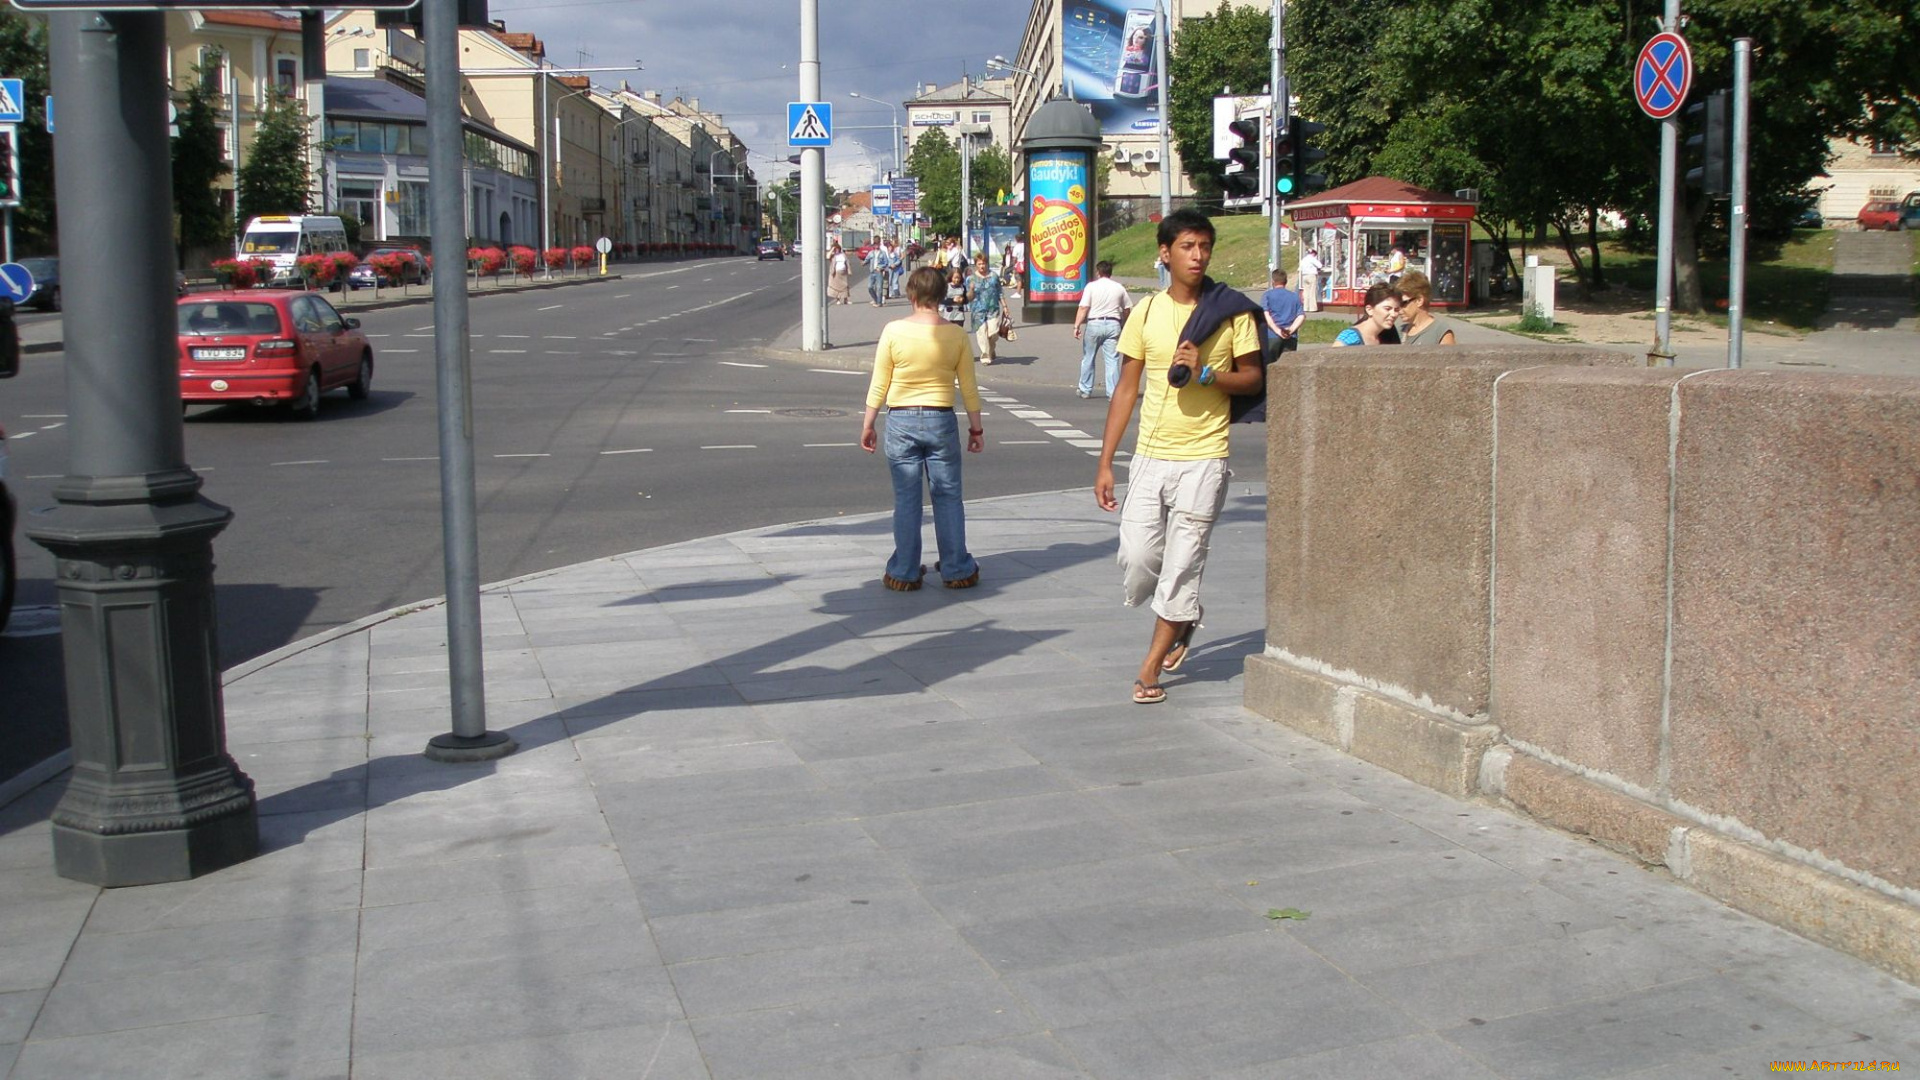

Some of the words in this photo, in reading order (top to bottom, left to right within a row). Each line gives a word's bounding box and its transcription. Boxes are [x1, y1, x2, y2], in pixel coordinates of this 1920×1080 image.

[1031, 166, 1078, 183] Gaudyk!
[1031, 218, 1080, 245] Nuolaidos
[1040, 282, 1075, 292] Drogas
